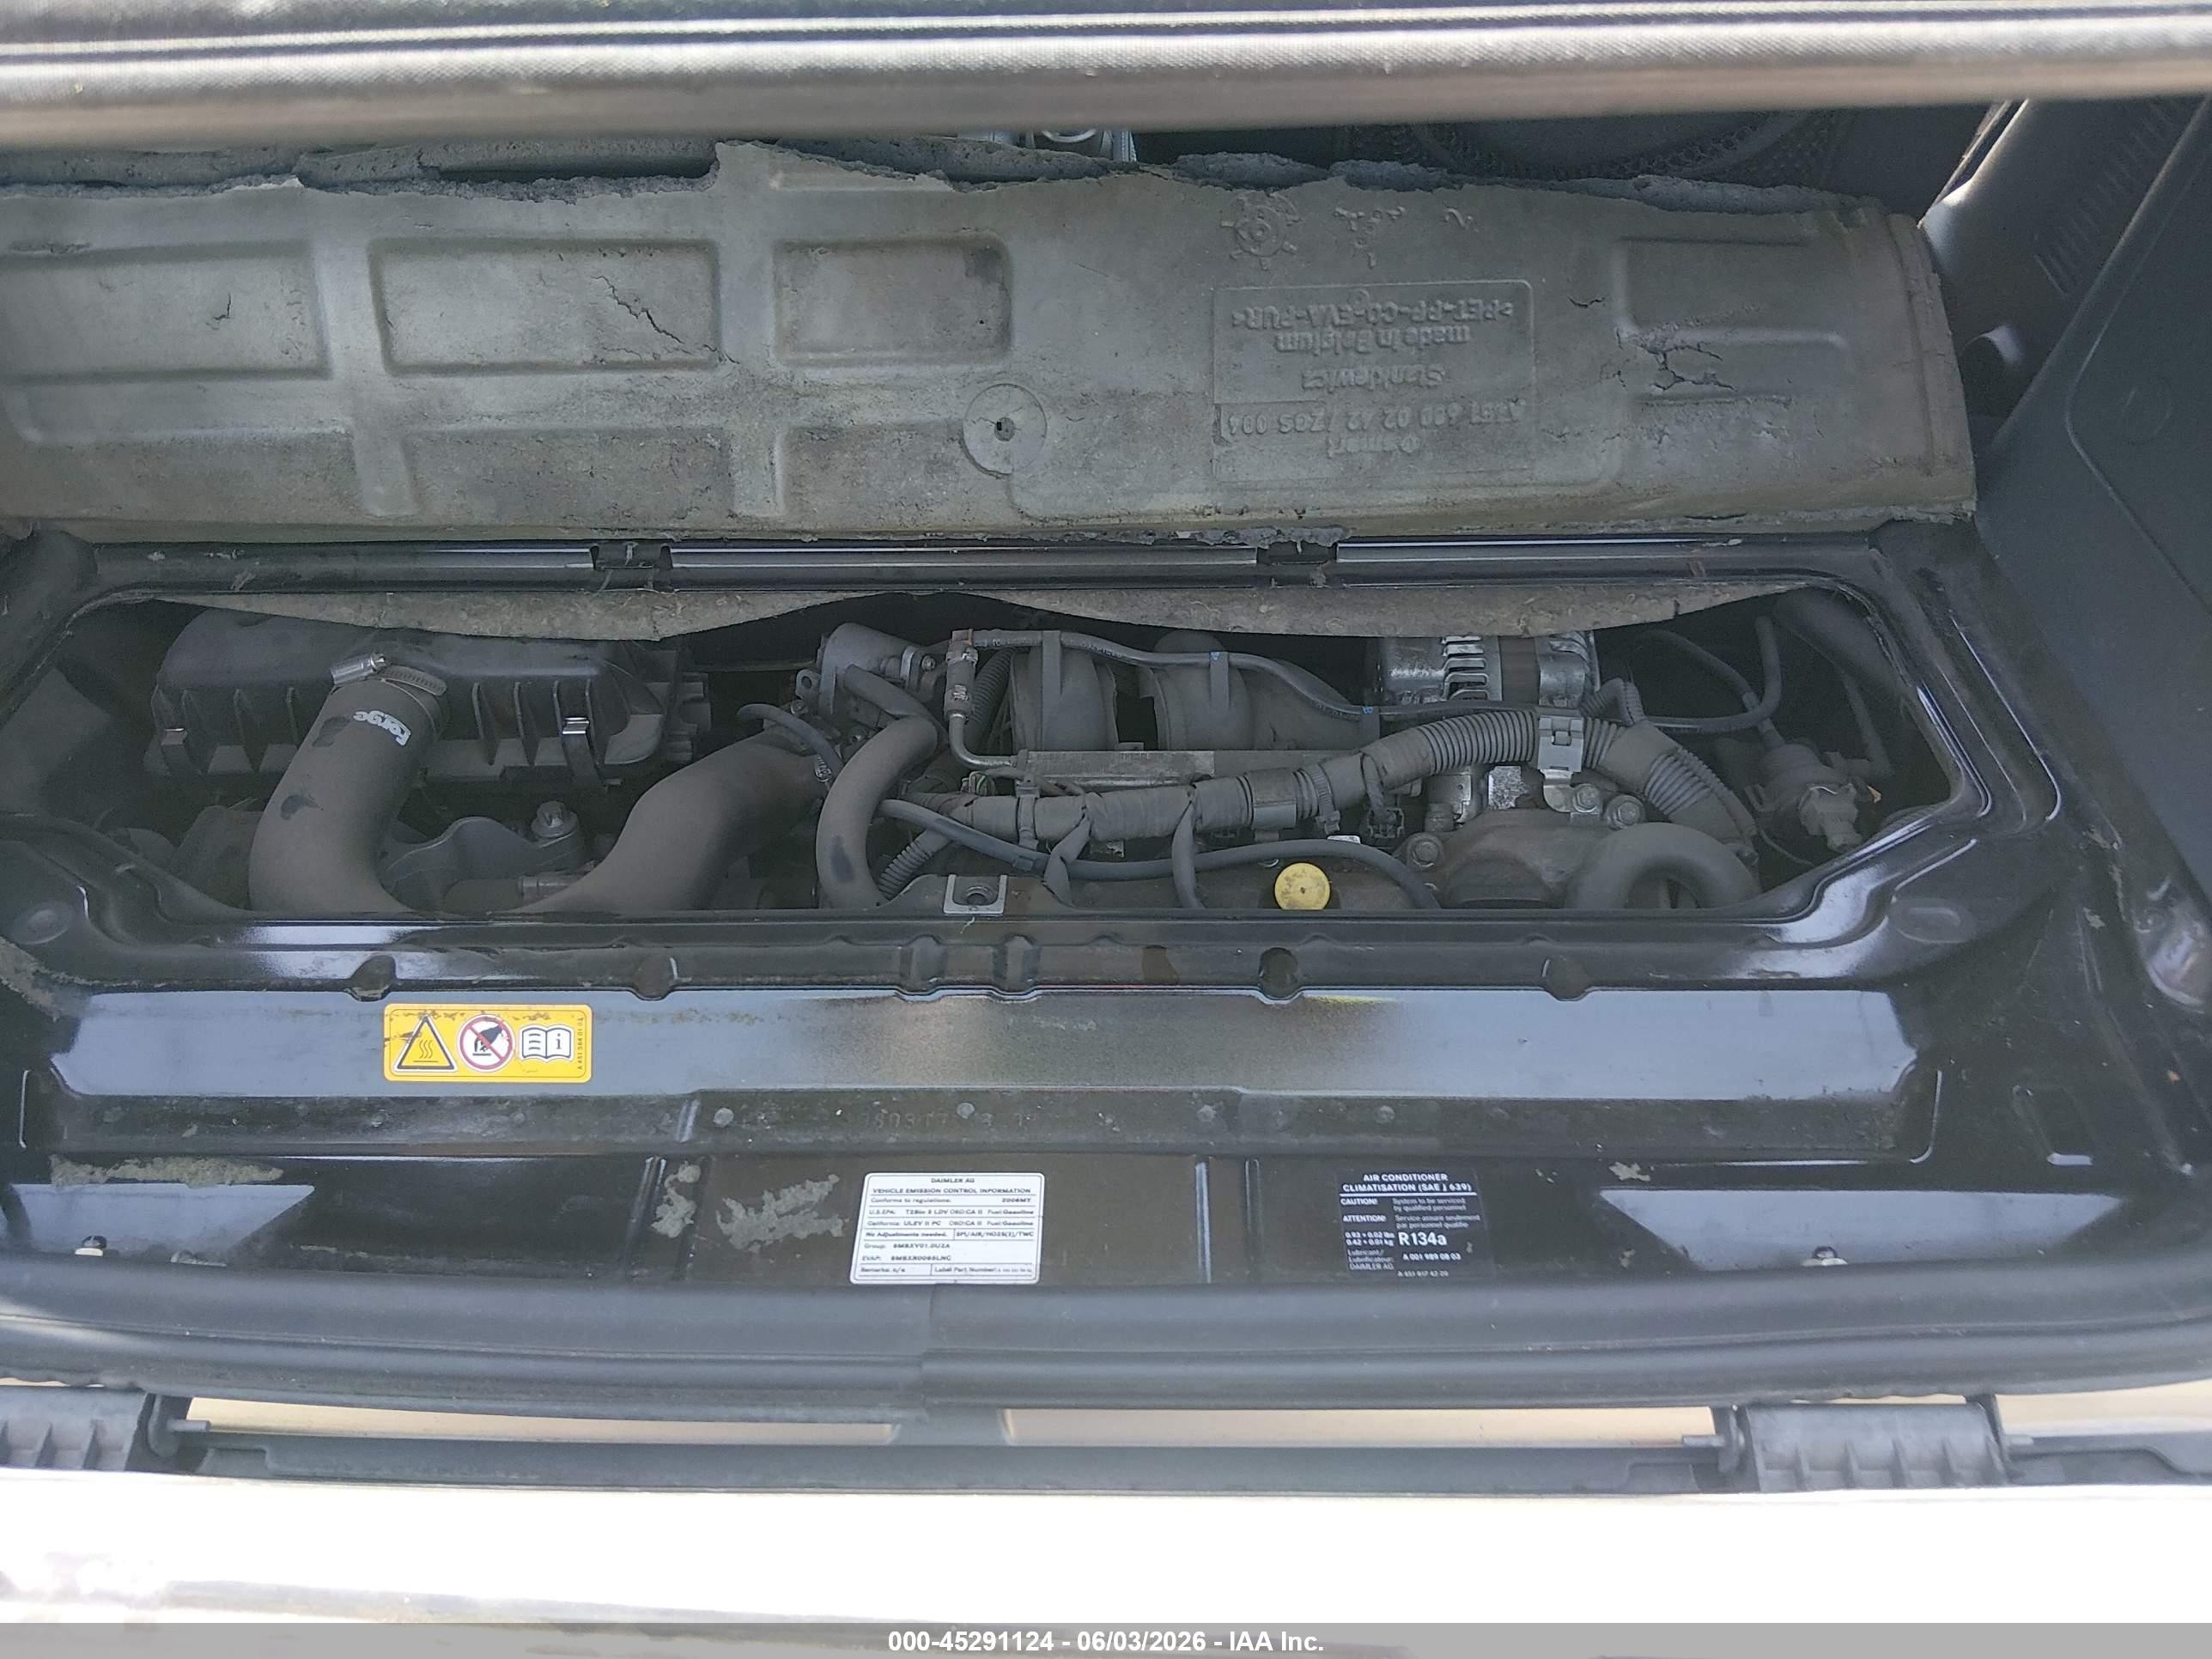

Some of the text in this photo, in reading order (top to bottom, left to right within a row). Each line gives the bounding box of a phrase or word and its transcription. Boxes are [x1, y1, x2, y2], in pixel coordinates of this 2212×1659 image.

[1273, 325, 1470, 356] made in Belgium
[1381, 1173, 1449, 1182] CONDITIONER
[1343, 1184, 1416, 1192] CLIMATISATION
[1418, 1184, 1440, 1192] (SAE
[1449, 1183, 1472, 1191] 639)
[1398, 1231, 1447, 1246] R134a
